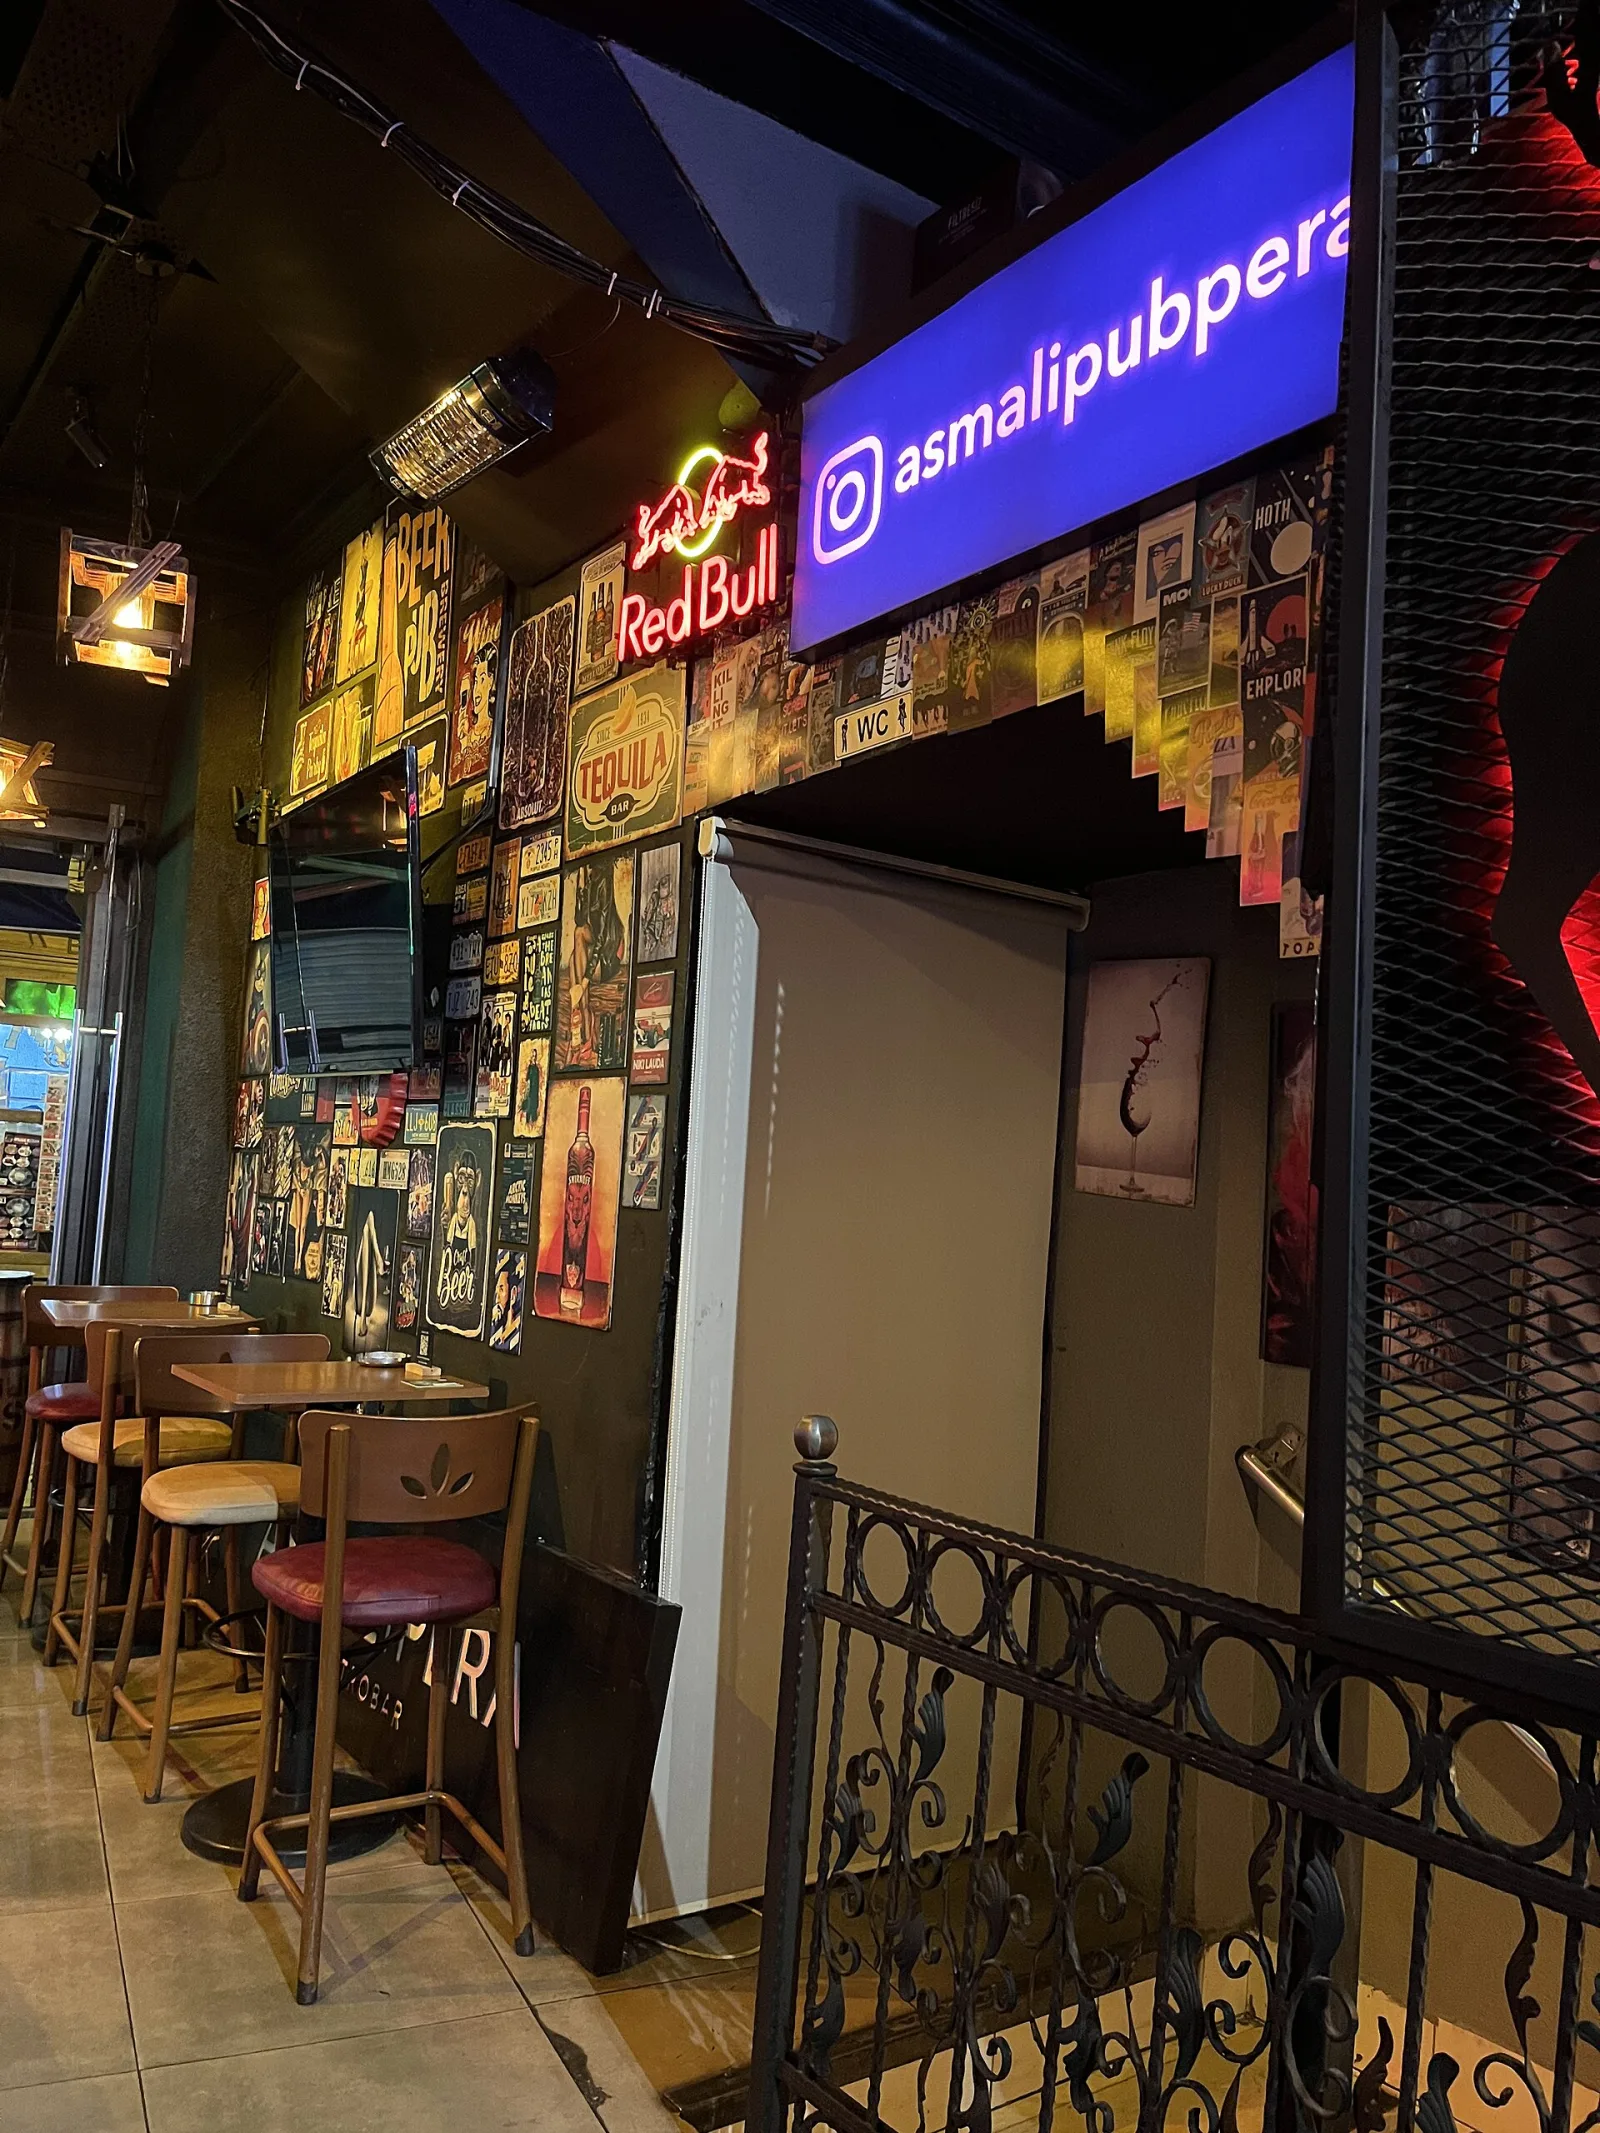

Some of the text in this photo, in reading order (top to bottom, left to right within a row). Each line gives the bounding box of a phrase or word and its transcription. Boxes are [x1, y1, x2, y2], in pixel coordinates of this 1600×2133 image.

[894, 195, 1351, 494] asmalipubpera
[1253, 498, 1292, 531] HOTH
[616, 563, 693, 662] Red
[699, 522, 779, 630] Bull
[1162, 587, 1192, 607] MO
[1201, 577, 1243, 597] LUCKY DUCK
[1130, 625, 1157, 653] FLOY
[713, 670, 732, 688] KIL
[712, 702, 729, 719] NG
[596, 727, 611, 744] SINCE
[857, 709, 889, 742] WC
[580, 731, 667, 803] TEQUILA
[516, 799, 543, 821] ABSOLUT
[611, 800, 629, 816] BAR
[1282, 942, 1315, 957] TOP
[645, 1057, 664, 1070] LAUDA
[437, 1246, 475, 1307] Beer
